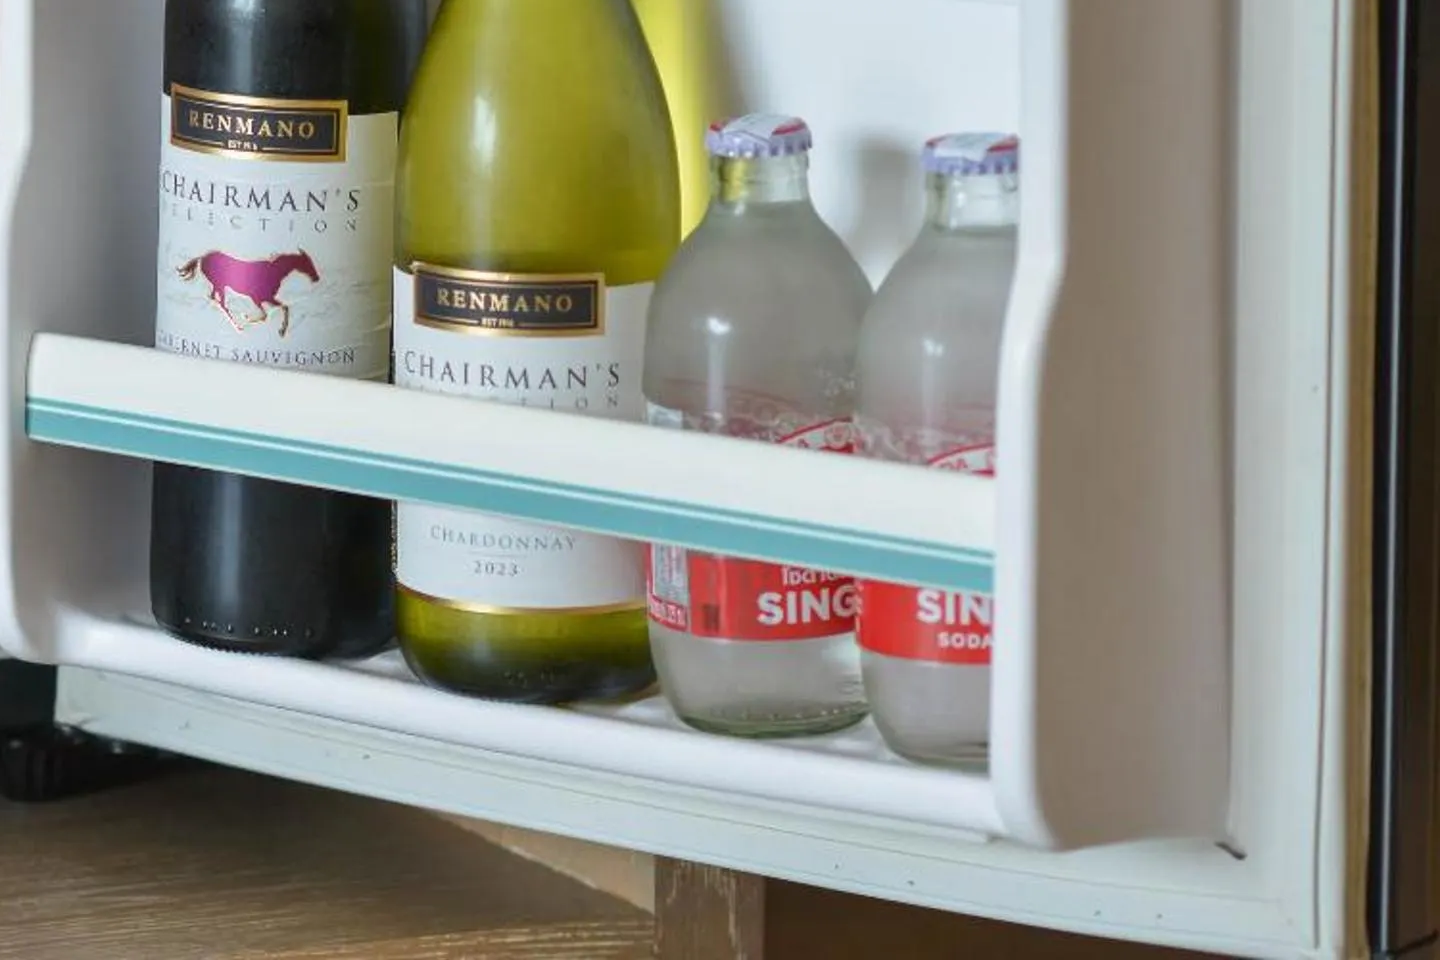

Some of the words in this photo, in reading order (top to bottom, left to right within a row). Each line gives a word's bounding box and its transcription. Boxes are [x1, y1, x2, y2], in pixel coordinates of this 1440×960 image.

[187, 108, 316, 140] RENMANO
[162, 170, 361, 213] CHAIRMAN'S
[162, 201, 358, 234] ELECTION
[436, 287, 573, 313] RENMANO
[232, 346, 356, 366] SAUVIGNON
[404, 350, 621, 390] CHAIRMAN'S
[429, 524, 577, 551] CHARDONNAY
[473, 560, 520, 577] 2023
